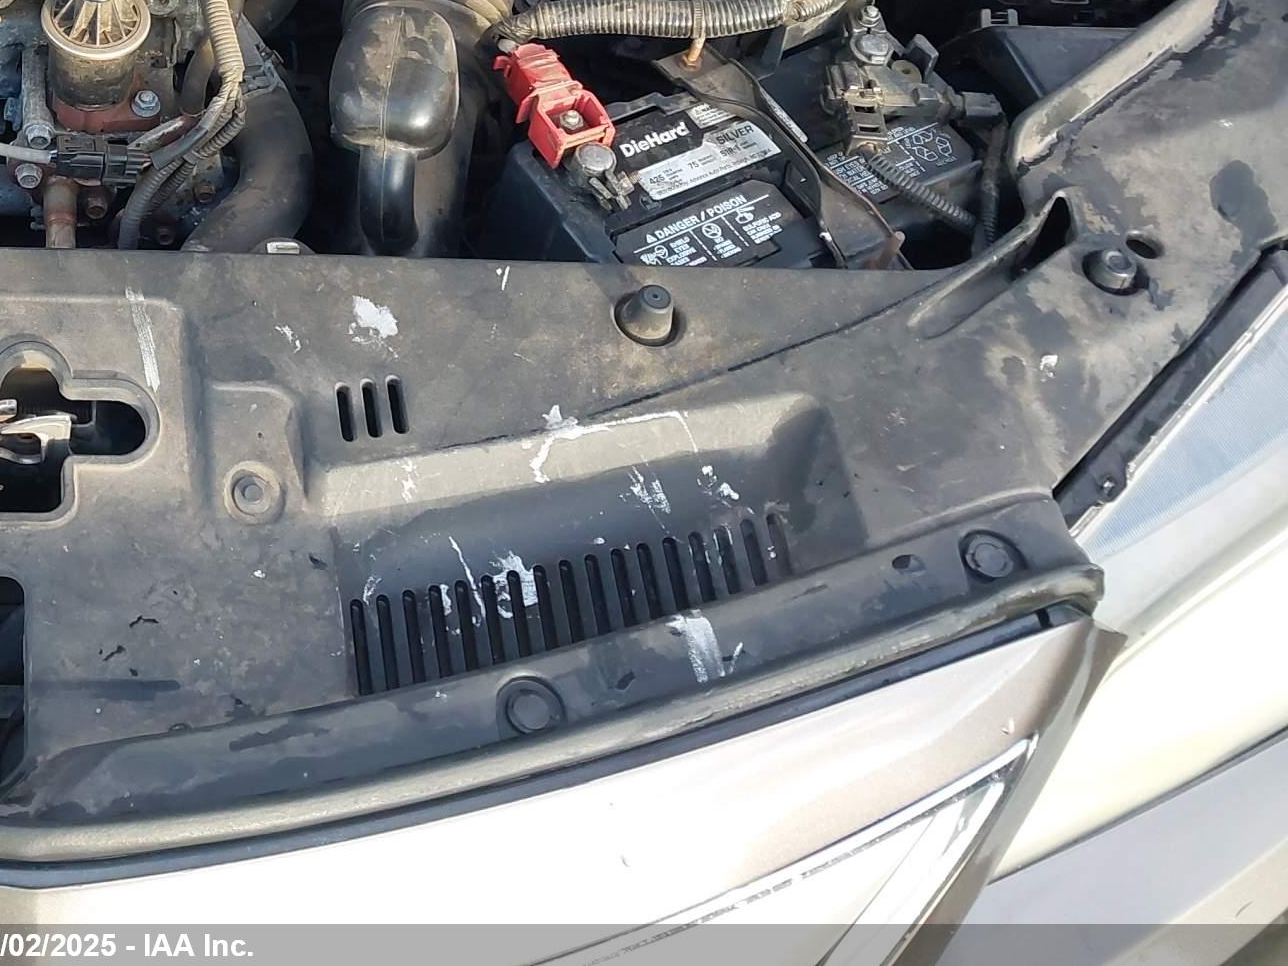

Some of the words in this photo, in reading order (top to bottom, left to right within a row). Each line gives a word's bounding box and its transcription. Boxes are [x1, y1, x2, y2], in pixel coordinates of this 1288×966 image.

[619, 122, 690, 158] DieHard
[716, 125, 755, 145] SILVER
[649, 174, 665, 185] 425
[688, 161, 699, 170] 75
[654, 215, 700, 239] DANGER
[707, 194, 748, 218] POISON
